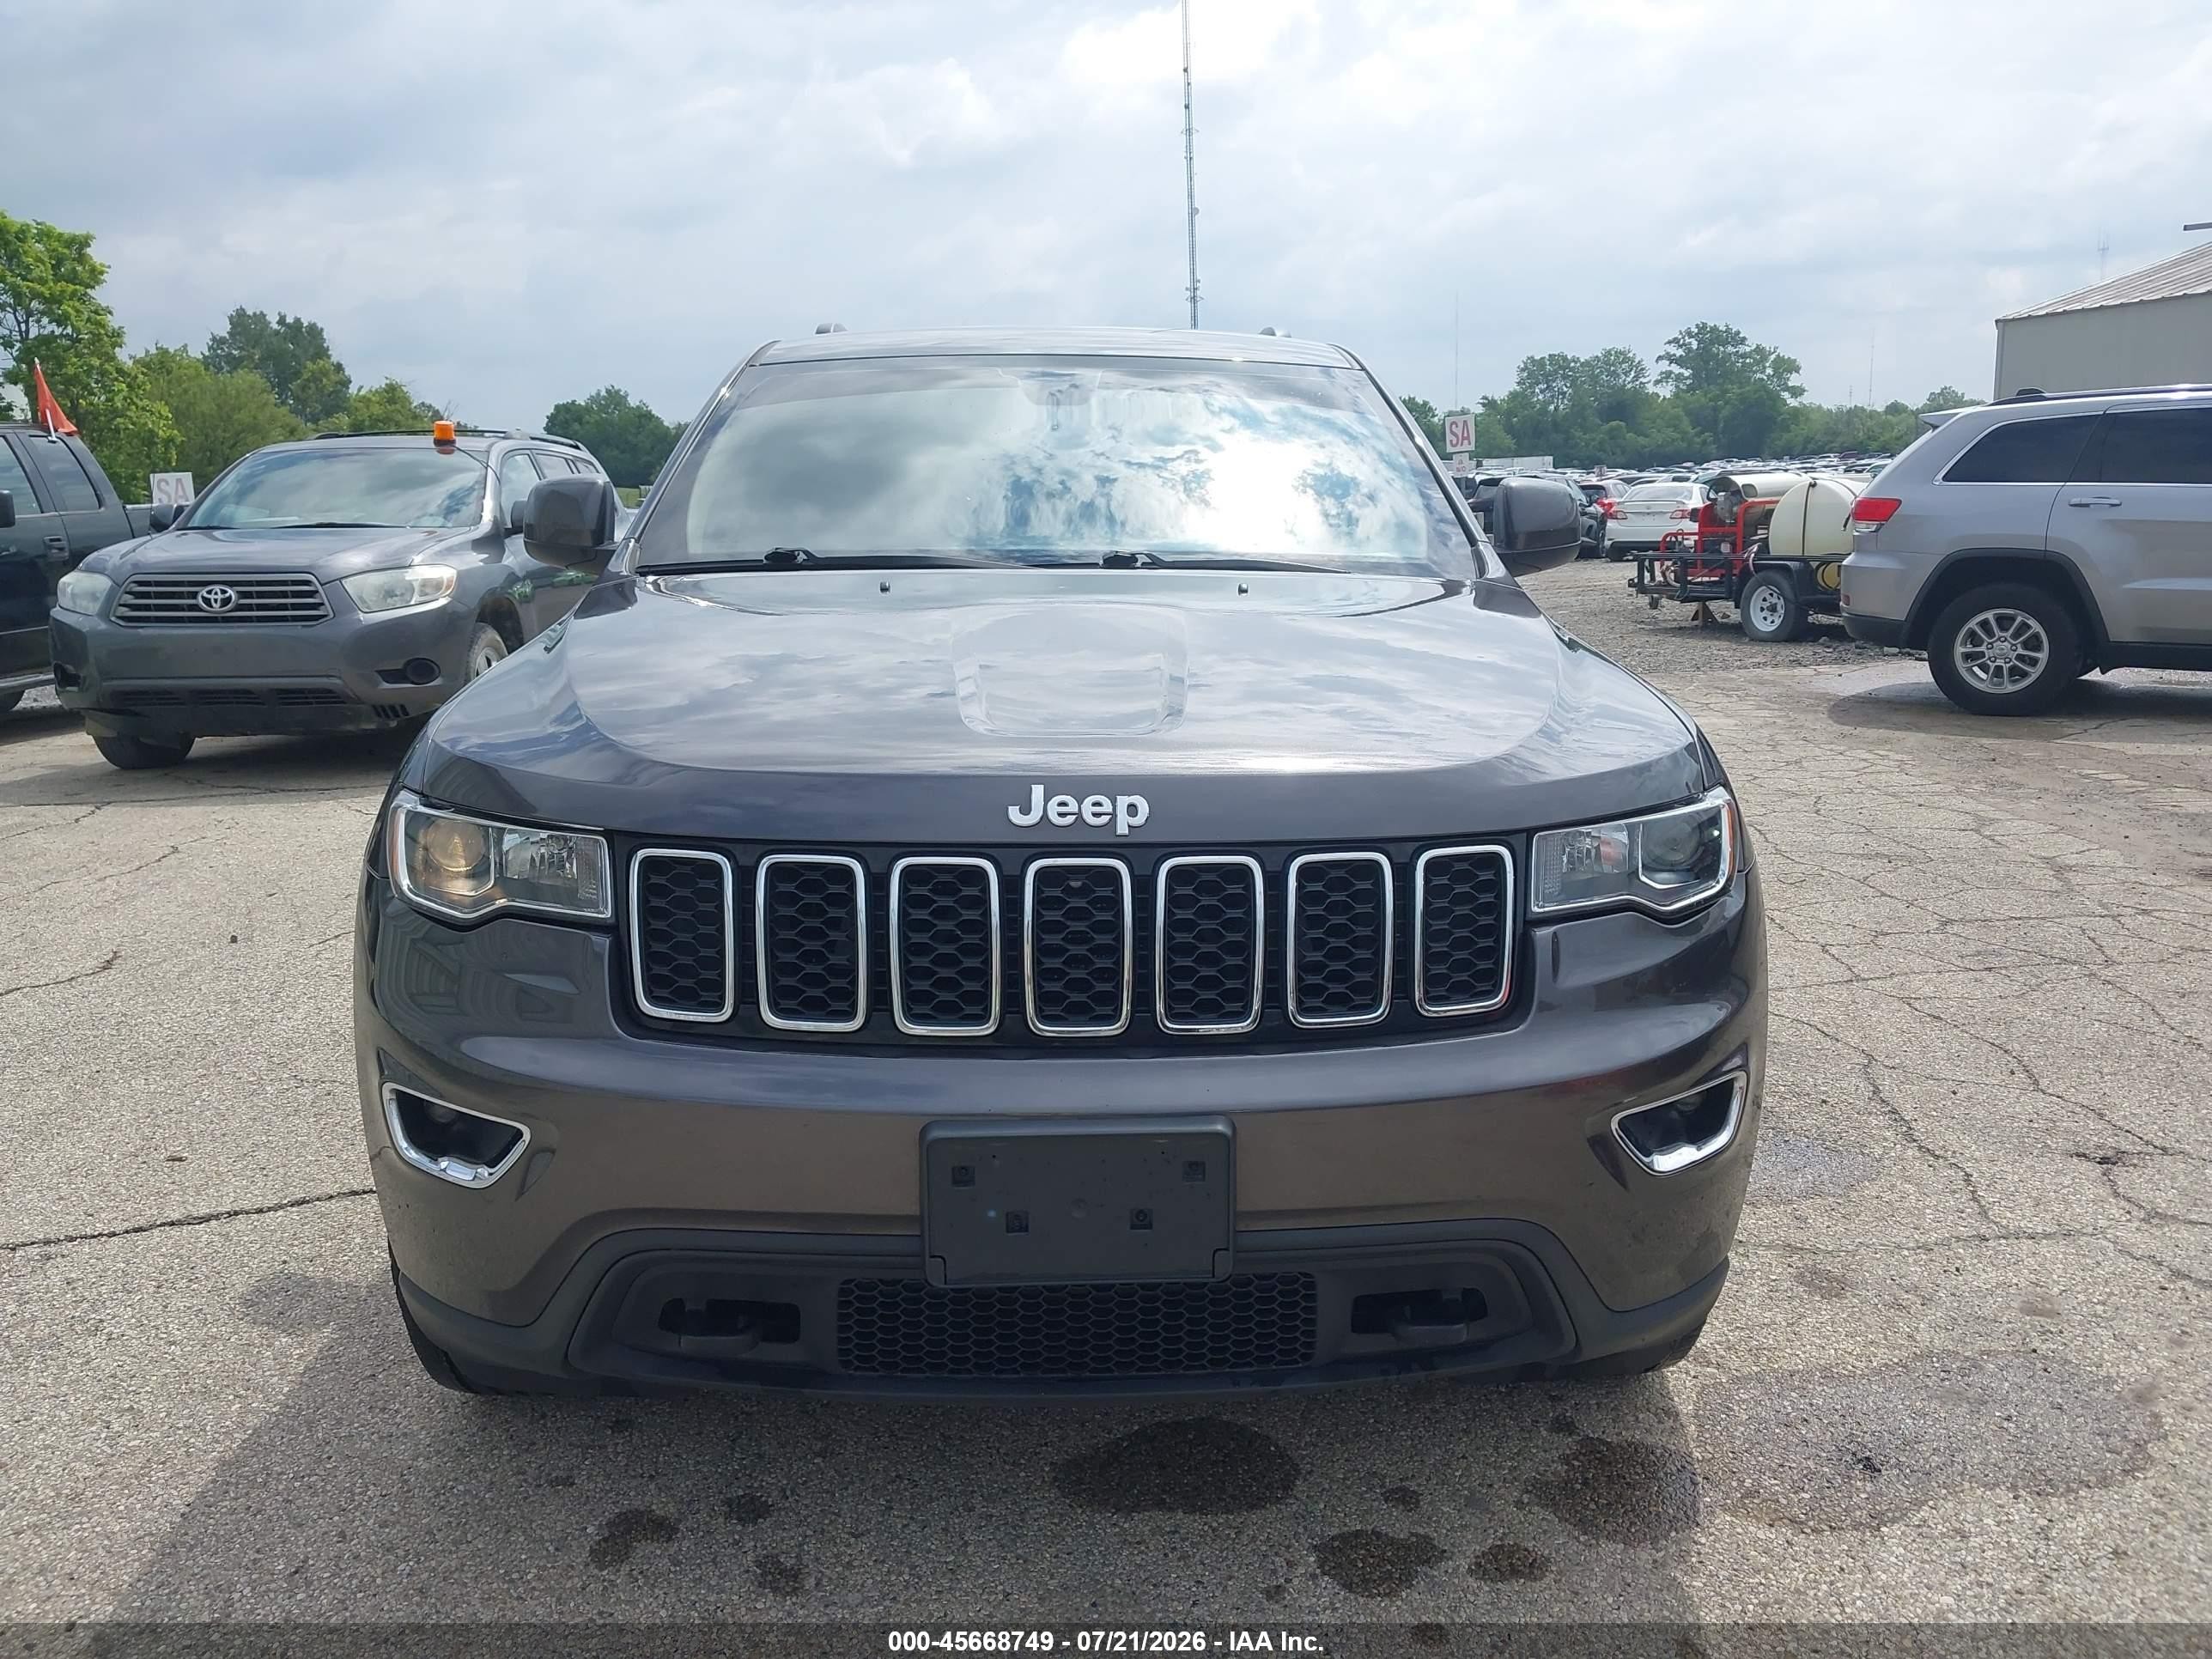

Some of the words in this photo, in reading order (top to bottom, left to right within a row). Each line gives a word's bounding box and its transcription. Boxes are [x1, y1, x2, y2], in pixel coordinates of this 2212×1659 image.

[1449, 420, 1471, 447] SA
[157, 477, 190, 504] SA
[1007, 784, 1150, 836] Jeep
